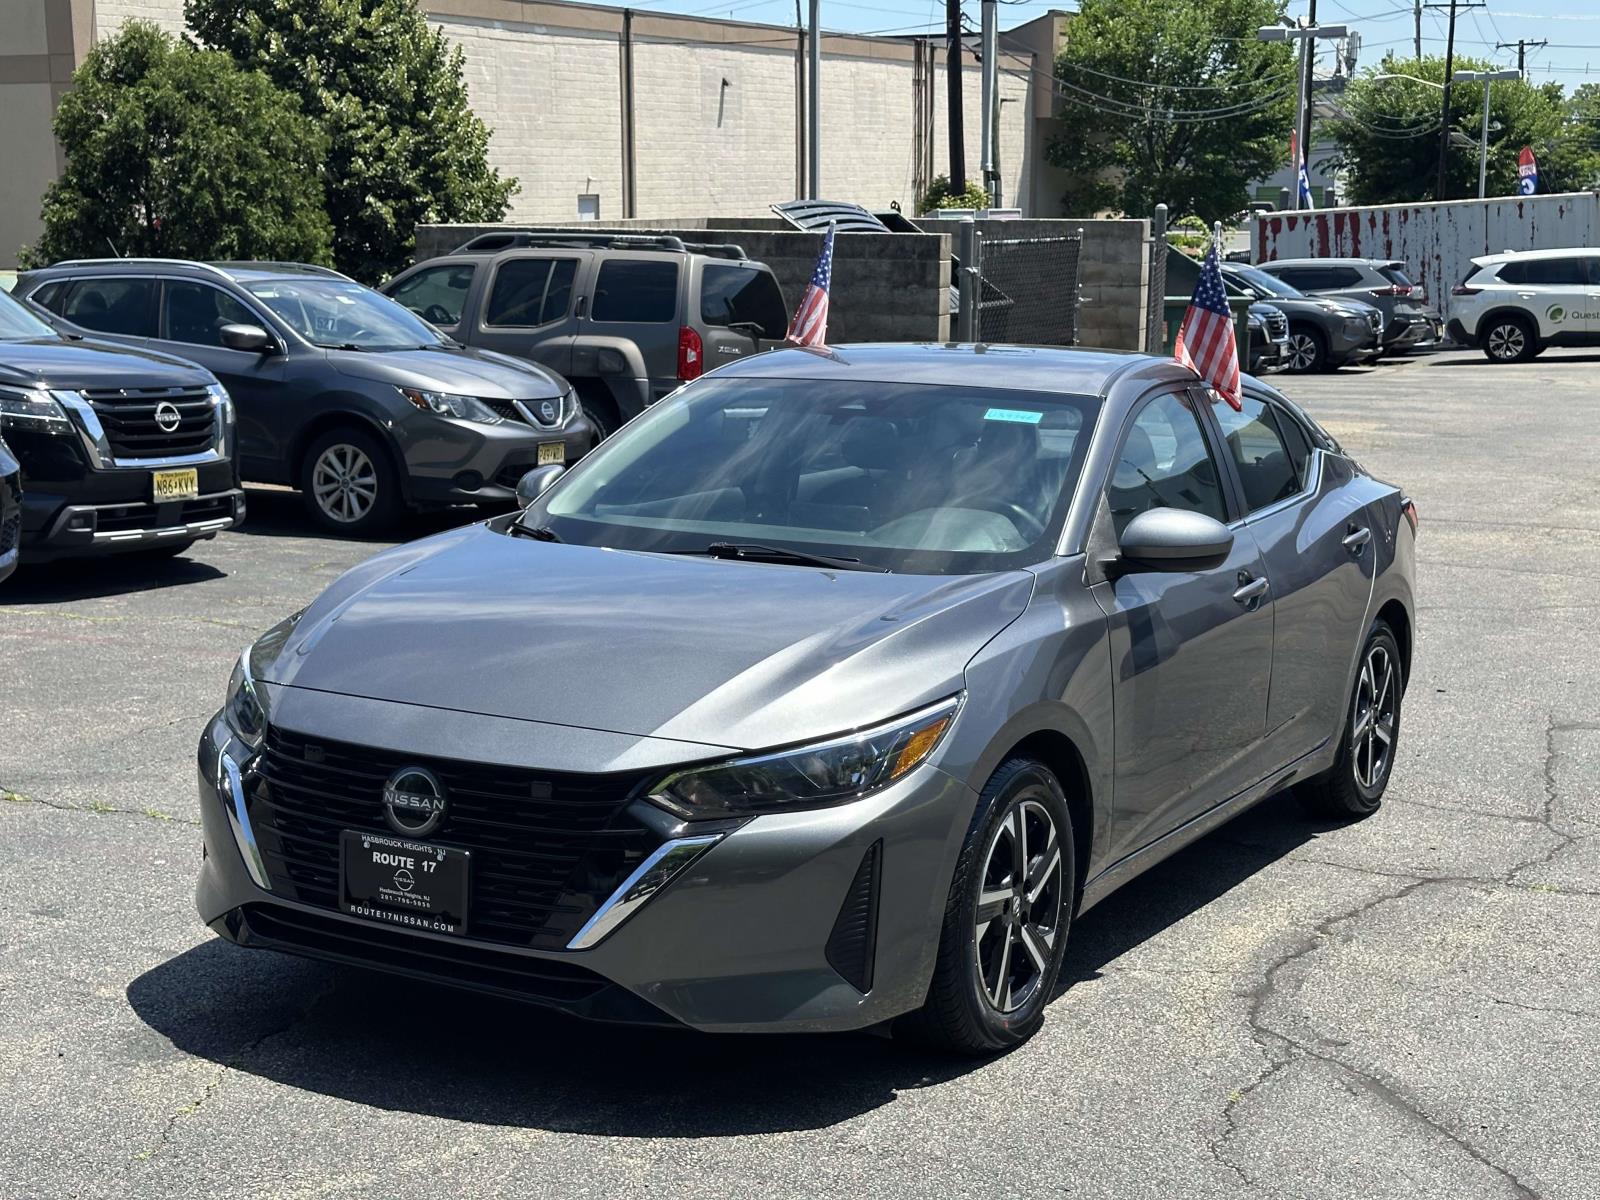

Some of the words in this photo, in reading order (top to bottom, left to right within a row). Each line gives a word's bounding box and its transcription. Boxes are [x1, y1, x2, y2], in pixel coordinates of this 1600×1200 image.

[384, 791, 445, 810] NISSAN
[361, 834, 403, 849] HASBROUCK
[372, 851, 415, 870] ROUTE
[421, 860, 437, 873] 17
[350, 904, 454, 932] ROUTE17NISSAN.COM
